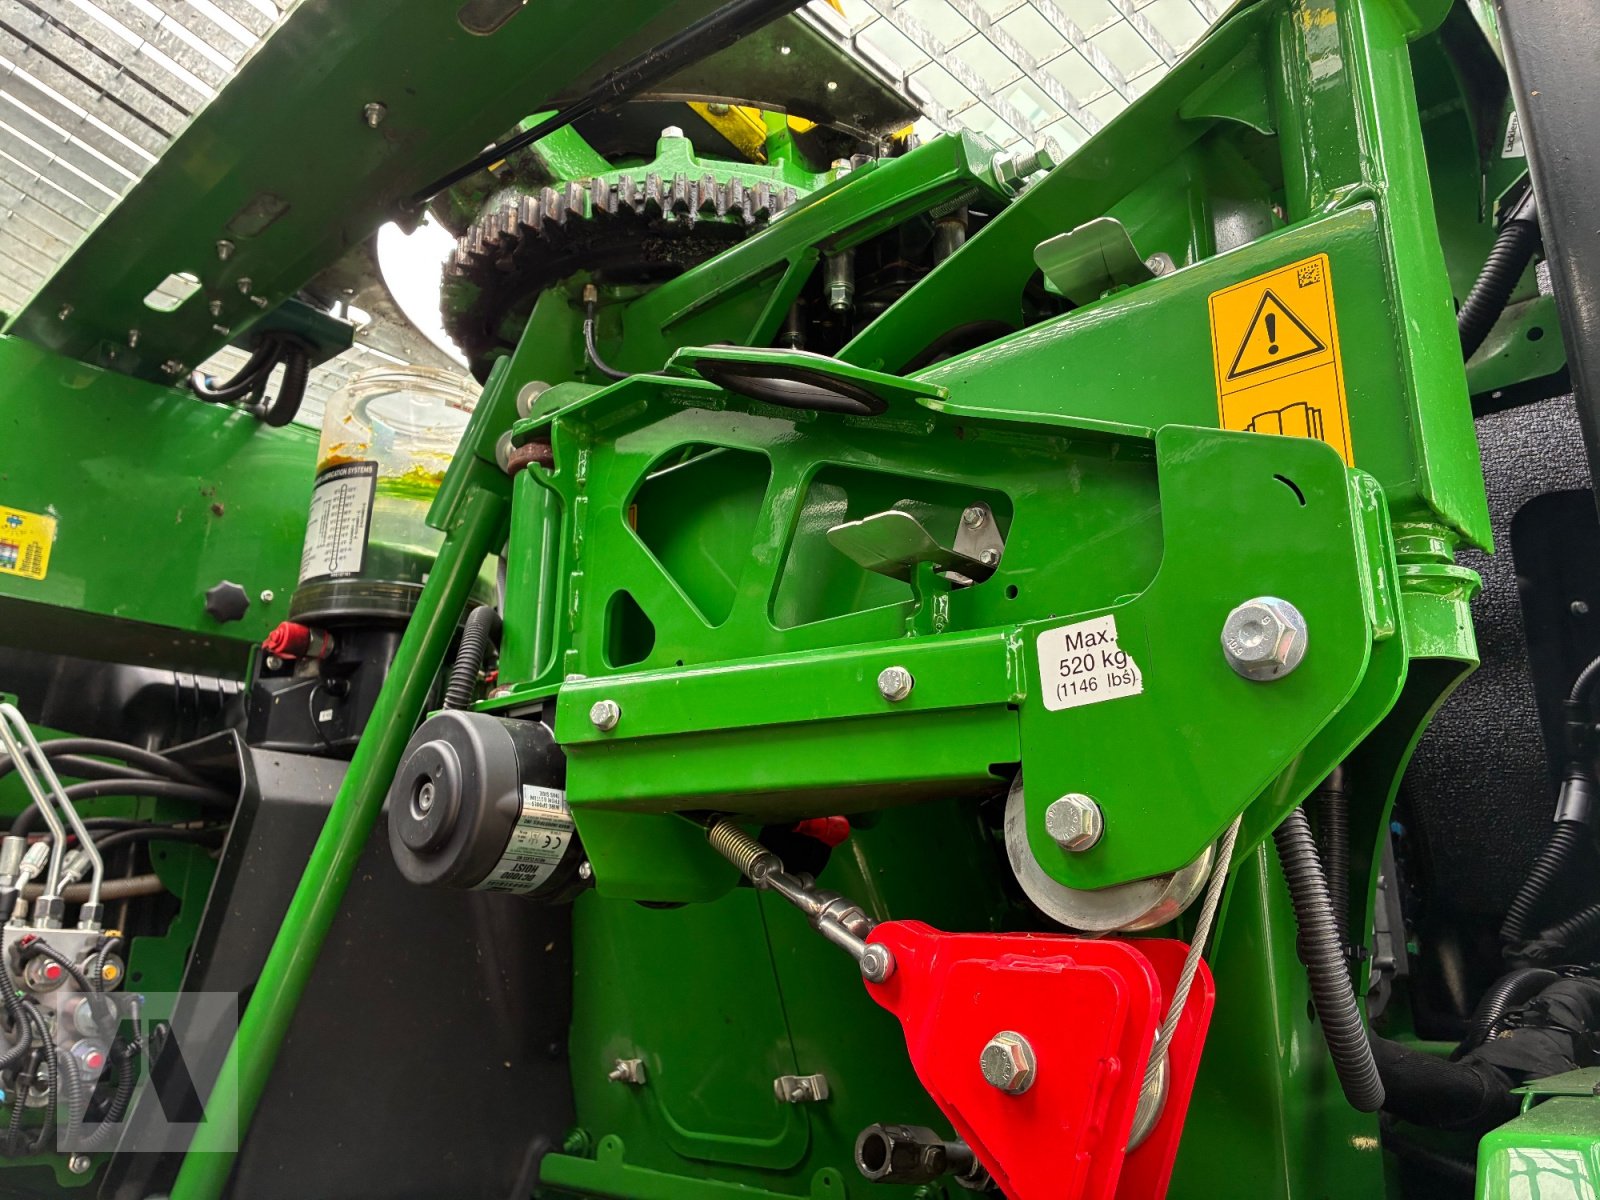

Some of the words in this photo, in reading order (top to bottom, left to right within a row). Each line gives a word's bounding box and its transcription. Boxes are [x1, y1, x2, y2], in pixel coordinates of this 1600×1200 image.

[347, 465, 373, 475] SYSTEMS
[1065, 630, 1114, 652] Max.
[1060, 653, 1095, 677] 520
[1102, 650, 1127, 669] kg
[1056, 677, 1098, 701] (1146
[1107, 668, 1136, 687] lbs)
[511, 863, 539, 873] HOIST
